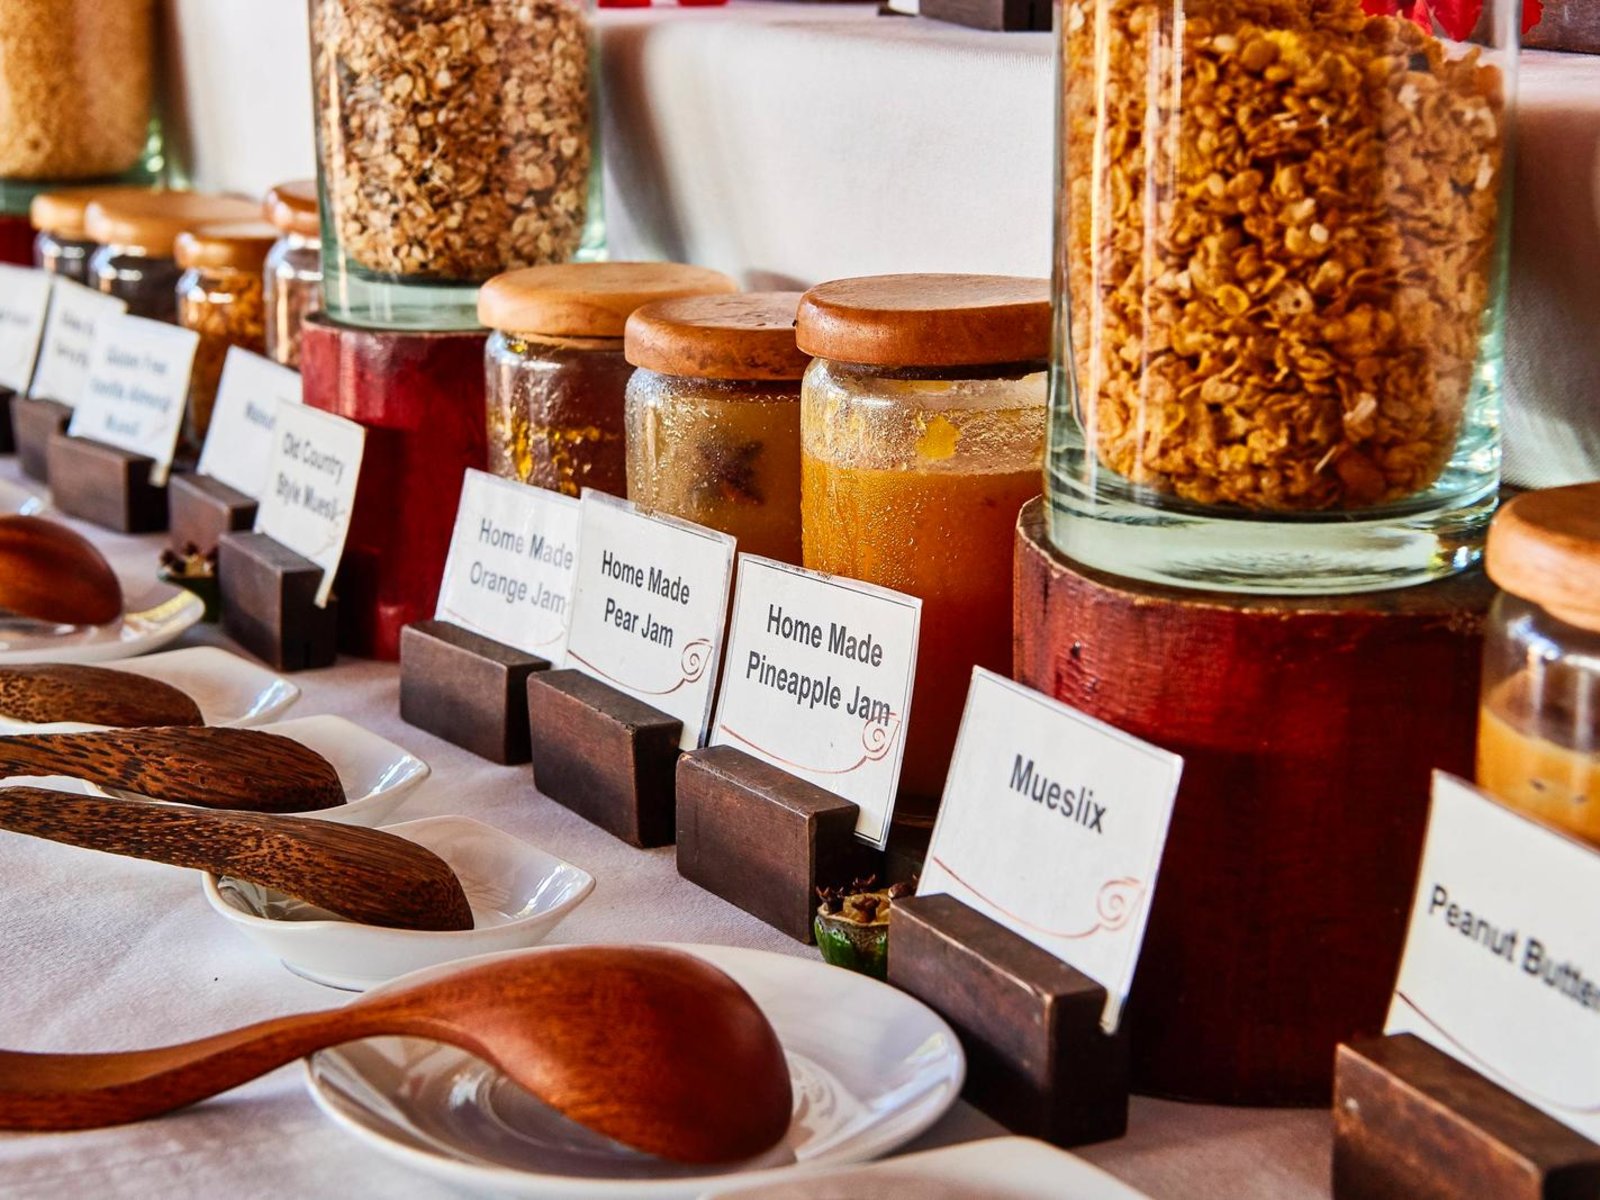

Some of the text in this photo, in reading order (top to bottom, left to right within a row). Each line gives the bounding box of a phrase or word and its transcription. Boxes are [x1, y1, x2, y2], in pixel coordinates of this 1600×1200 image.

[303, 440, 345, 485] Country
[478, 517, 574, 570] Home Made
[470, 561, 566, 615] Orange Jam
[601, 550, 691, 605] Home Made
[604, 597, 674, 648] Pear Jam
[766, 603, 883, 668] Home Made
[745, 650, 891, 726] Pineapple Jam
[1009, 753, 1107, 834] Mueslix
[1428, 884, 1518, 964] Peanut
